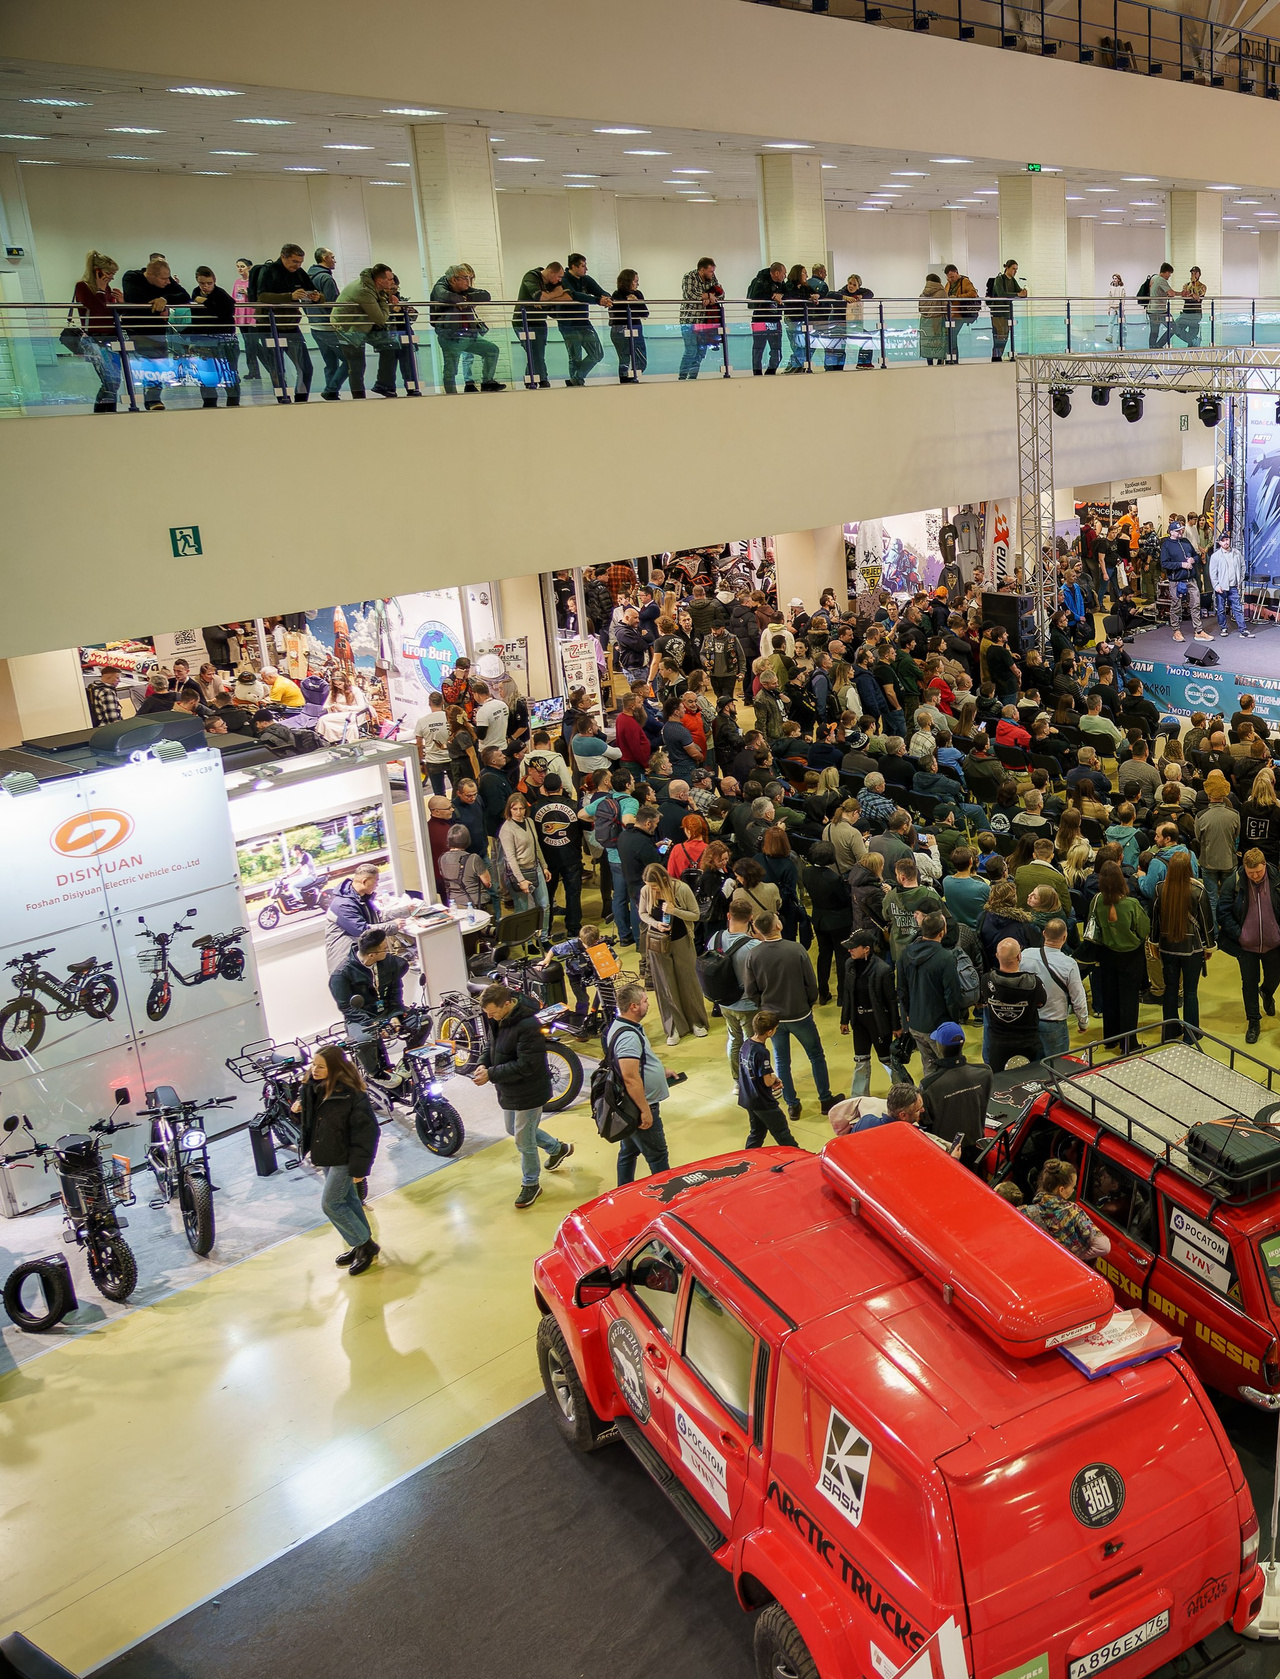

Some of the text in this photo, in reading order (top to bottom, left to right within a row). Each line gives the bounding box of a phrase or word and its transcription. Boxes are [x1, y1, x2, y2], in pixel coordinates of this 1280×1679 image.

[405, 642, 452, 662] Iron Butt
[1170, 667, 1223, 682] МОТО ЗИМА 24
[1171, 707, 1191, 717] МОТО
[26, 858, 200, 911] Foshan Disiyuan Electric Vehicle Co.,Ltd
[56, 854, 144, 887] DISIYUAN
[1184, 1222, 1225, 1256] РОСАТОМ
[1185, 1250, 1215, 1275] LYNX
[1060, 1323, 1093, 1339] EVEREST
[1195, 1320, 1260, 1375] USSR
[687, 1428, 724, 1479] РОСАТОМ
[822, 1474, 861, 1520] BASK
[767, 1480, 927, 1656] ARCTIC TRUCKS
[1077, 1615, 1164, 1678] А896ЕХ 76
